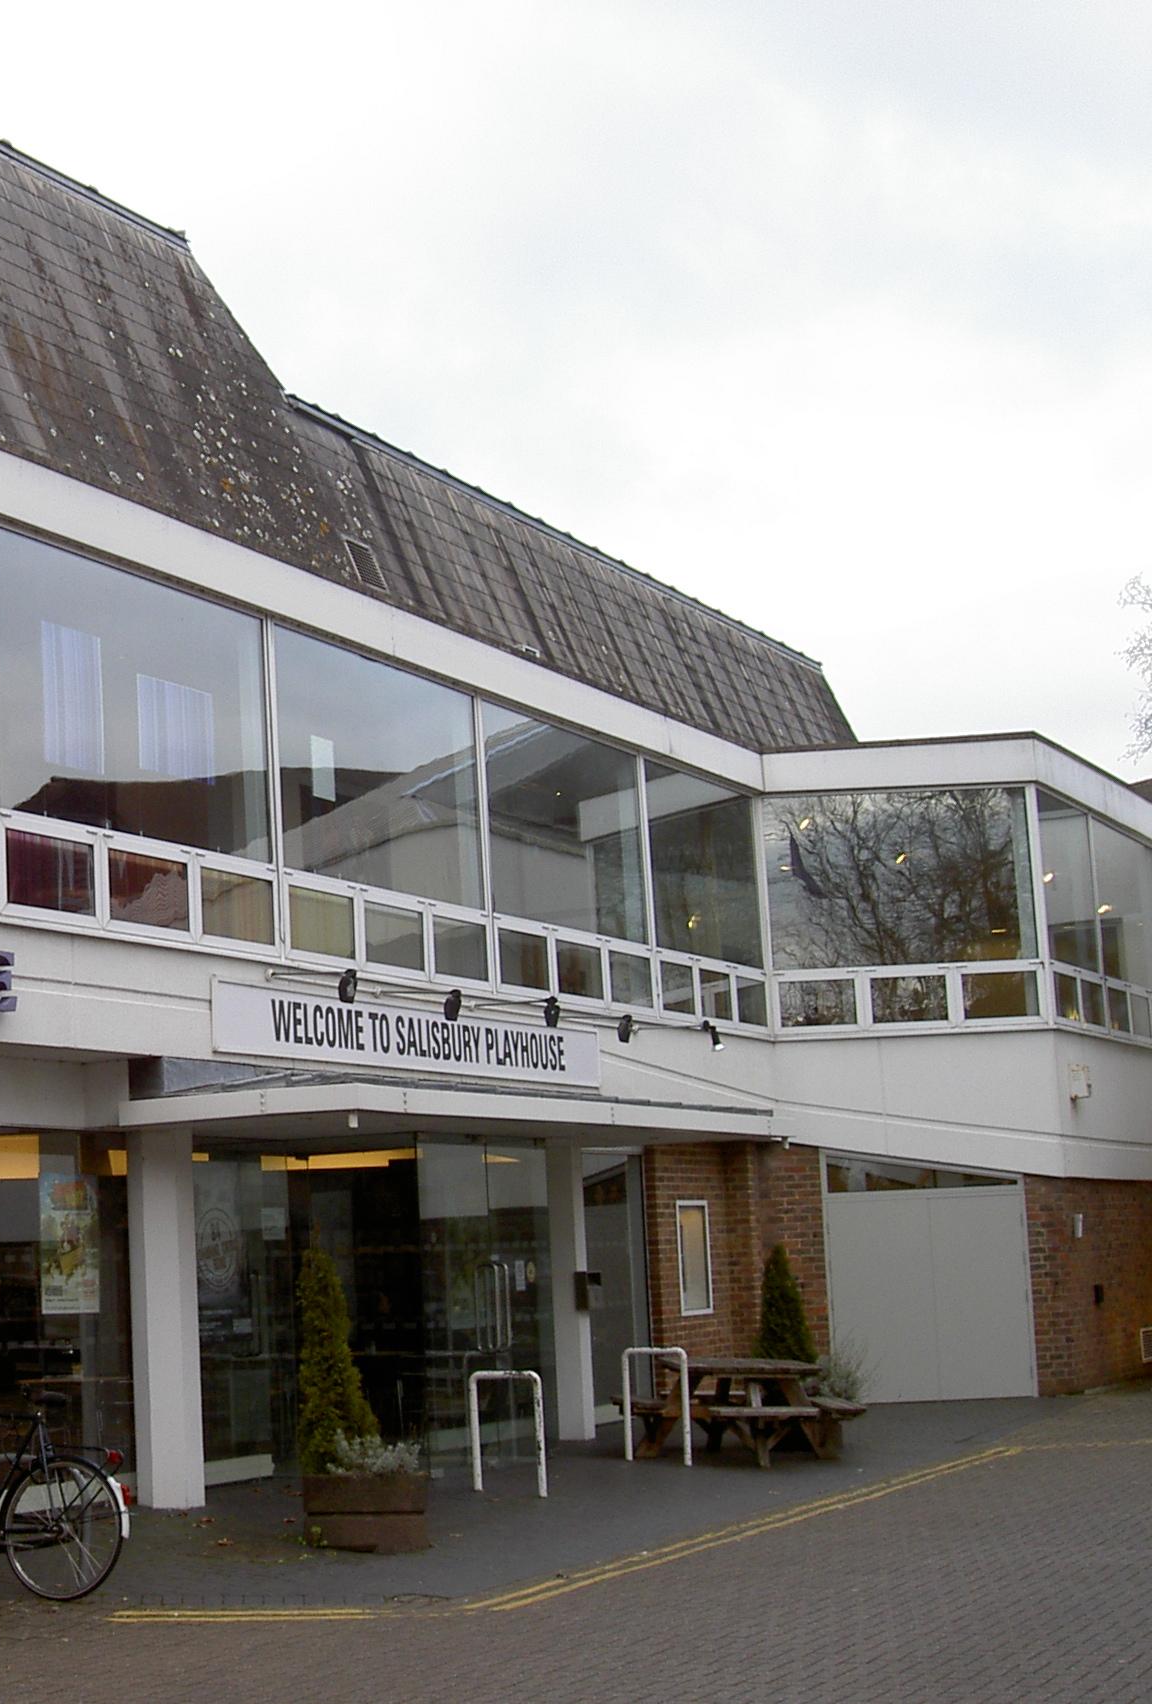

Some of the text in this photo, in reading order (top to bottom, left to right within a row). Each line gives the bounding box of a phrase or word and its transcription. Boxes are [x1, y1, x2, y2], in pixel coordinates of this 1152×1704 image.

[271, 999, 566, 1072] WELCOME TO SALISBURY PLAYHOUSE
